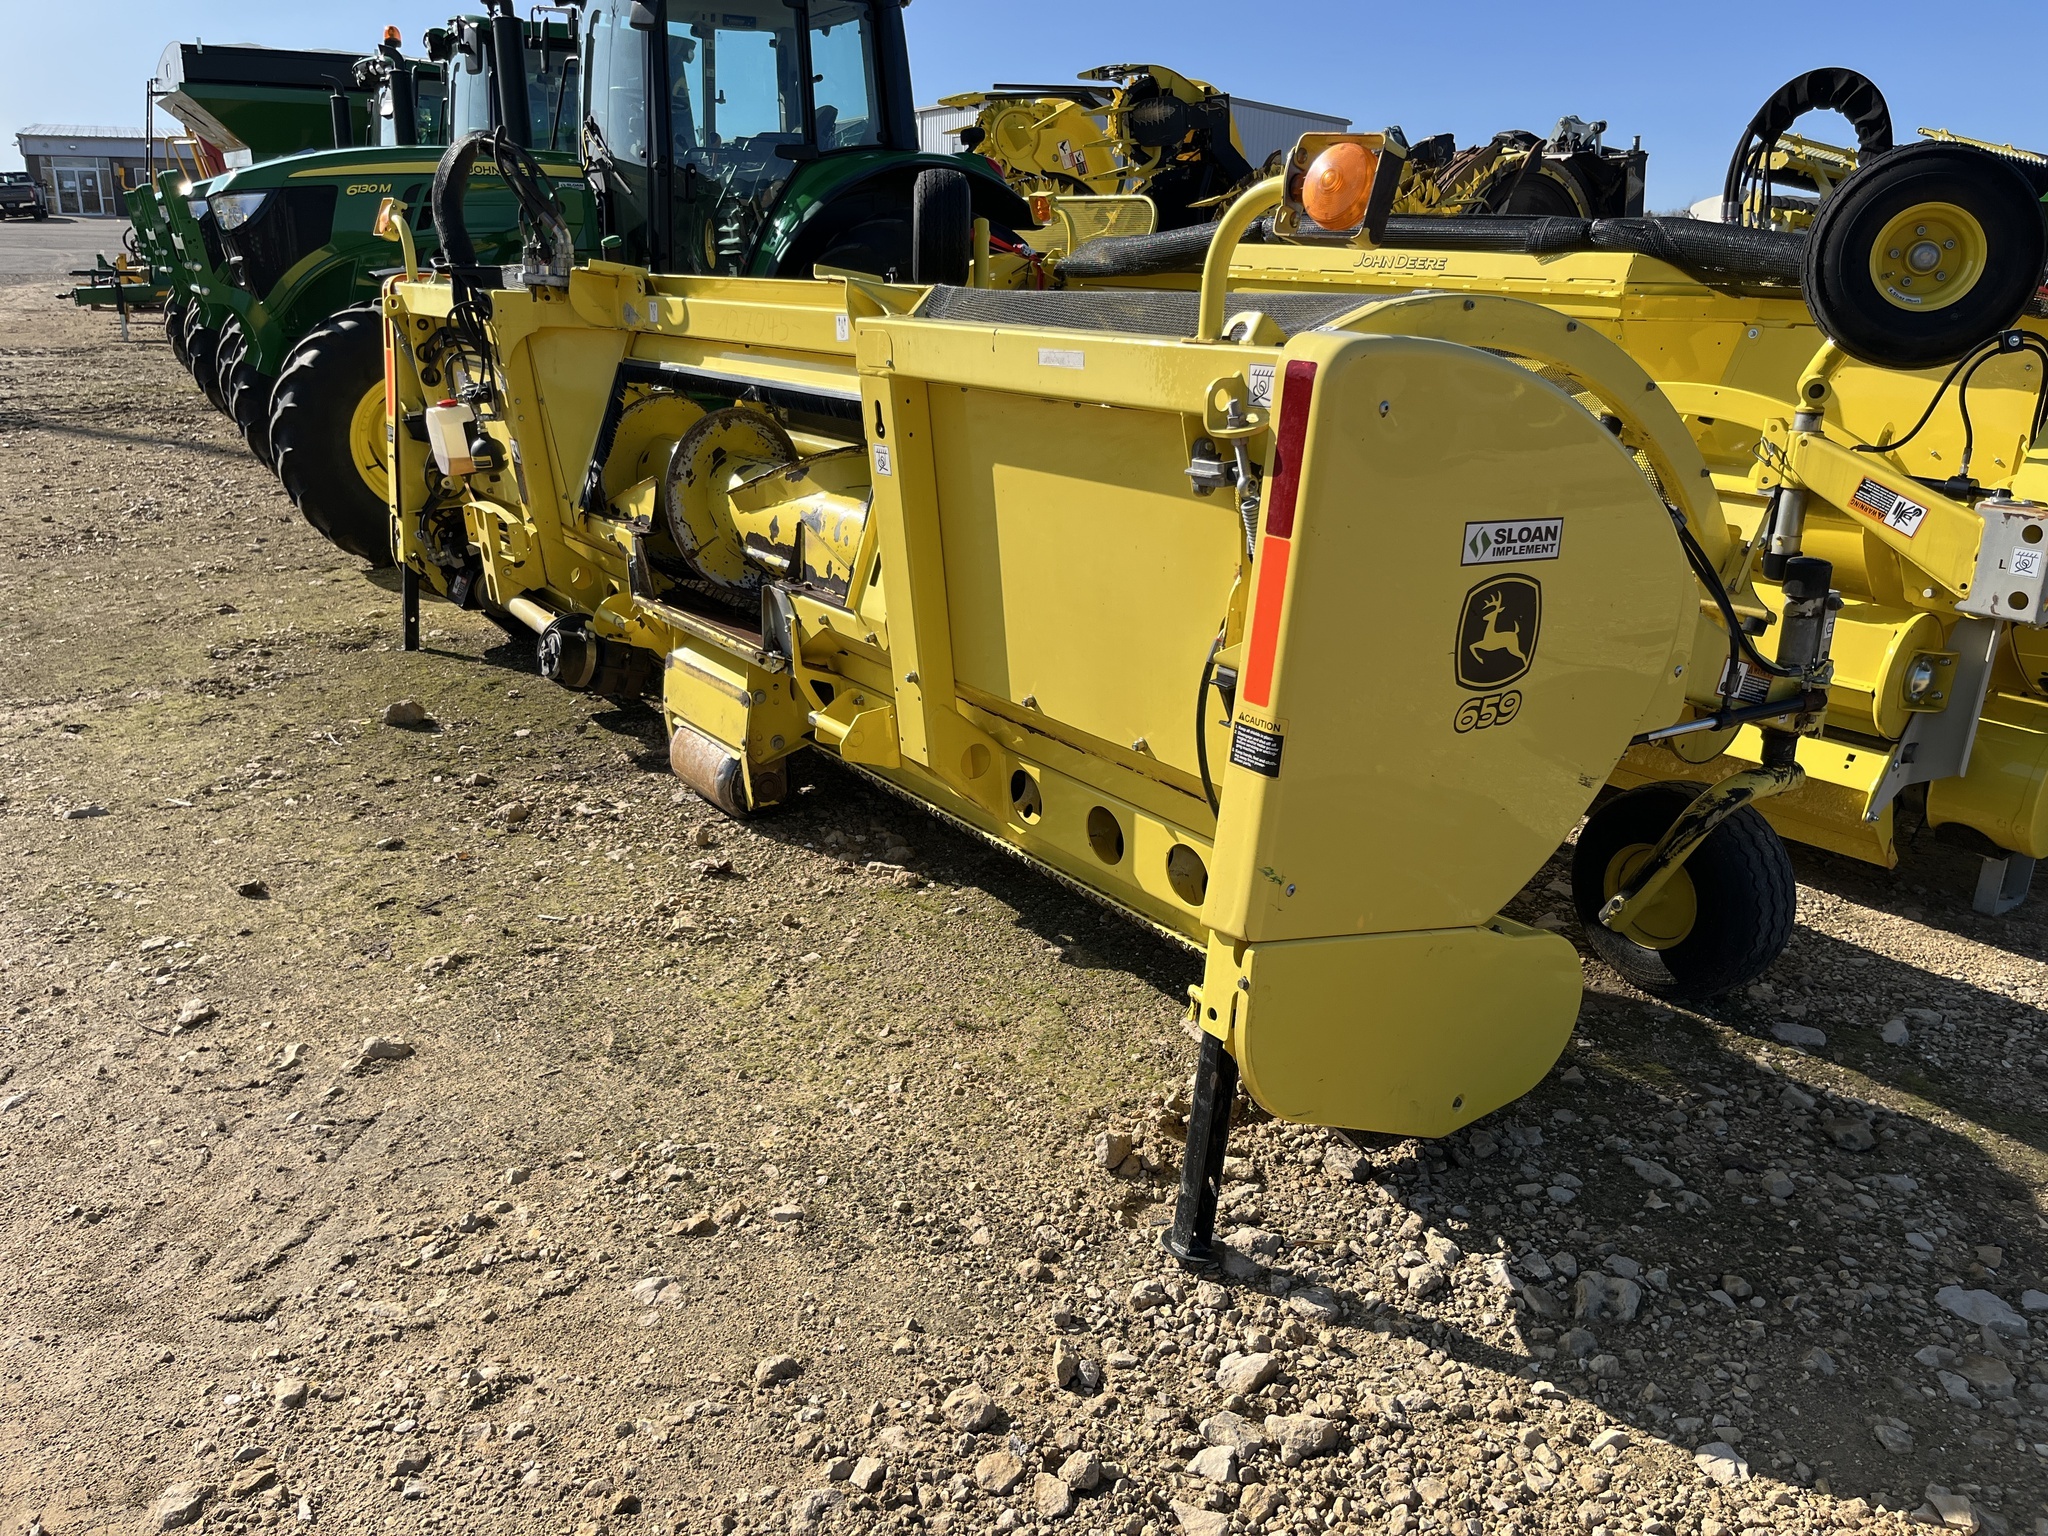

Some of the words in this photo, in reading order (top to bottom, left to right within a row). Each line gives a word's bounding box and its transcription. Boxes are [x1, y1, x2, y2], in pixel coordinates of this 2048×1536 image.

[1353, 253, 1395, 268] JOHN
[1394, 254, 1447, 270] DEERE
[1850, 499, 1878, 518] WARNING
[1493, 525, 1558, 545] SLOAN
[1492, 543, 1556, 557] IMPLEMENT
[1454, 690, 1522, 733] 659
[1245, 714, 1281, 732] CAUTION
